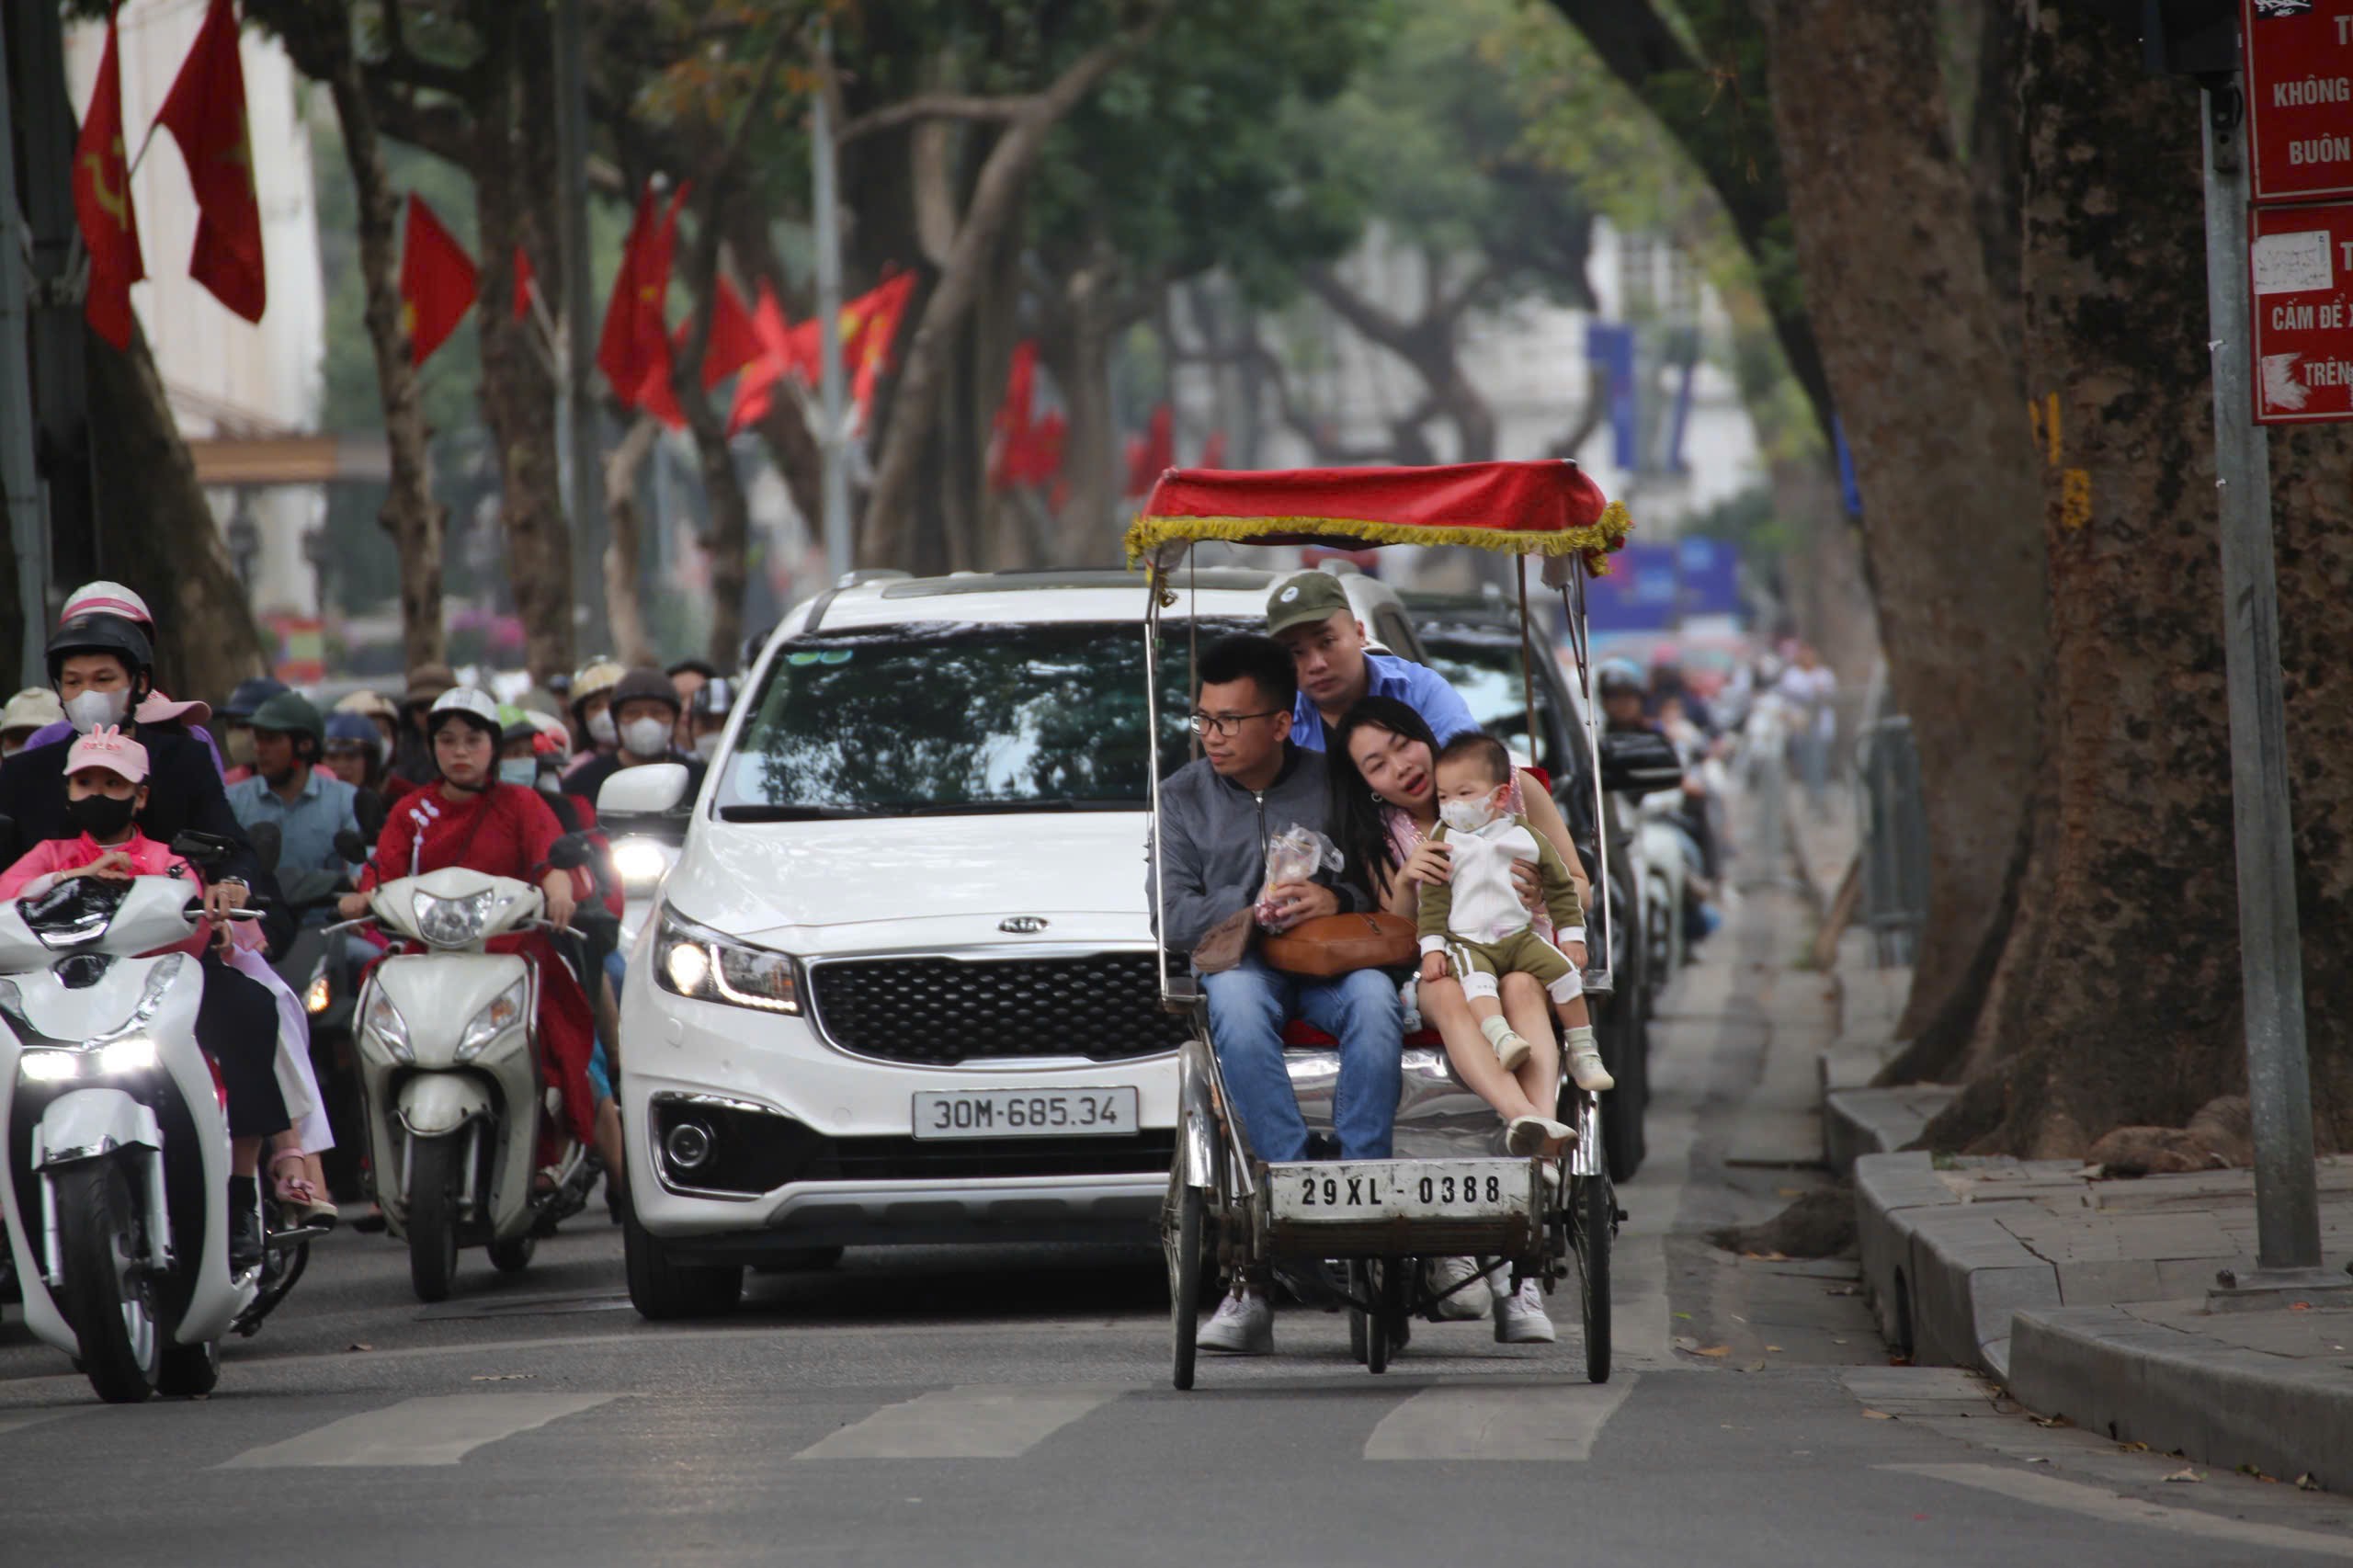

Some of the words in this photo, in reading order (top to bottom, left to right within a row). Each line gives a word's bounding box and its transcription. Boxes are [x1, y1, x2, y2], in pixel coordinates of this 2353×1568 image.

[2273, 75, 2349, 107] KHÔNG
[2289, 133, 2350, 165] BUÔN
[2272, 298, 2313, 330] CẤM
[2304, 356, 2350, 386] TRÊN
[933, 1096, 1118, 1129] 30M-685.34
[1419, 1176, 1500, 1203] 0388
